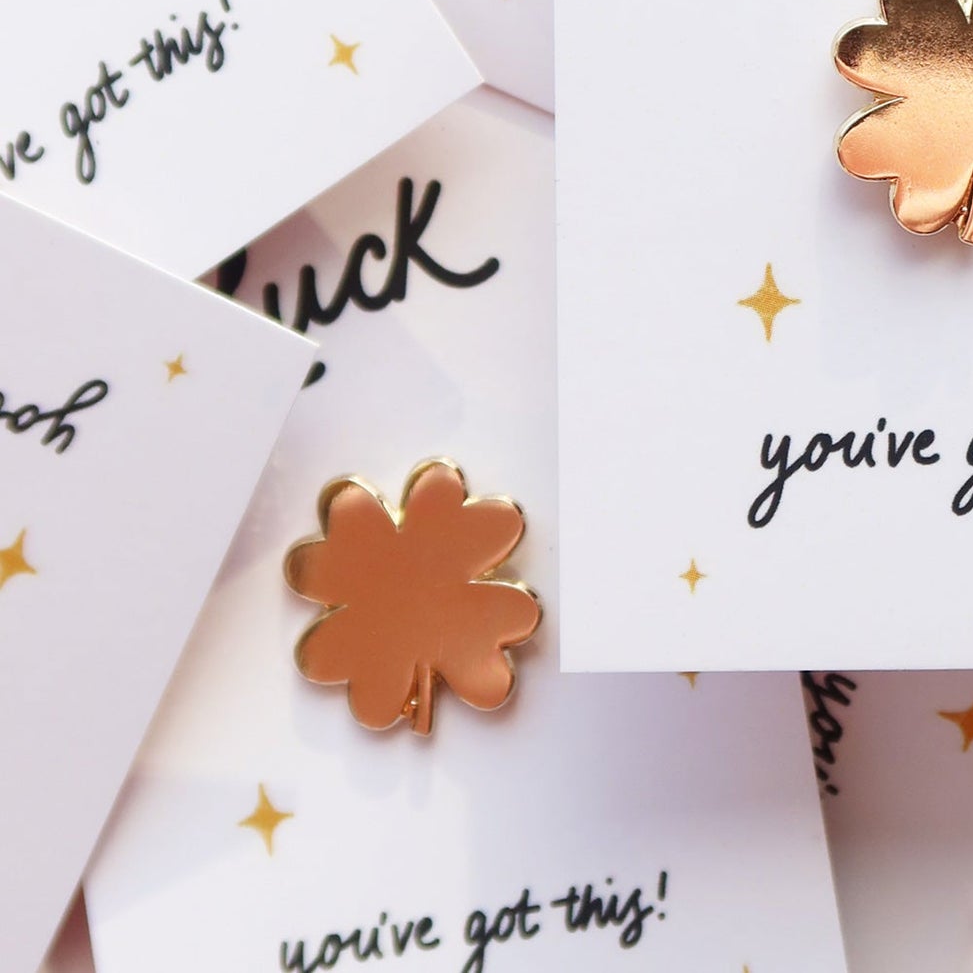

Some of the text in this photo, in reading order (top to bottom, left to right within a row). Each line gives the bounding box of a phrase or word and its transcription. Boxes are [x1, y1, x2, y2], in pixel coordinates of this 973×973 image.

[59, 59, 131, 186] got
[213, 176, 501, 337] uck
[746, 416, 941, 529] you've
[278, 869, 669, 973] you've got this!
